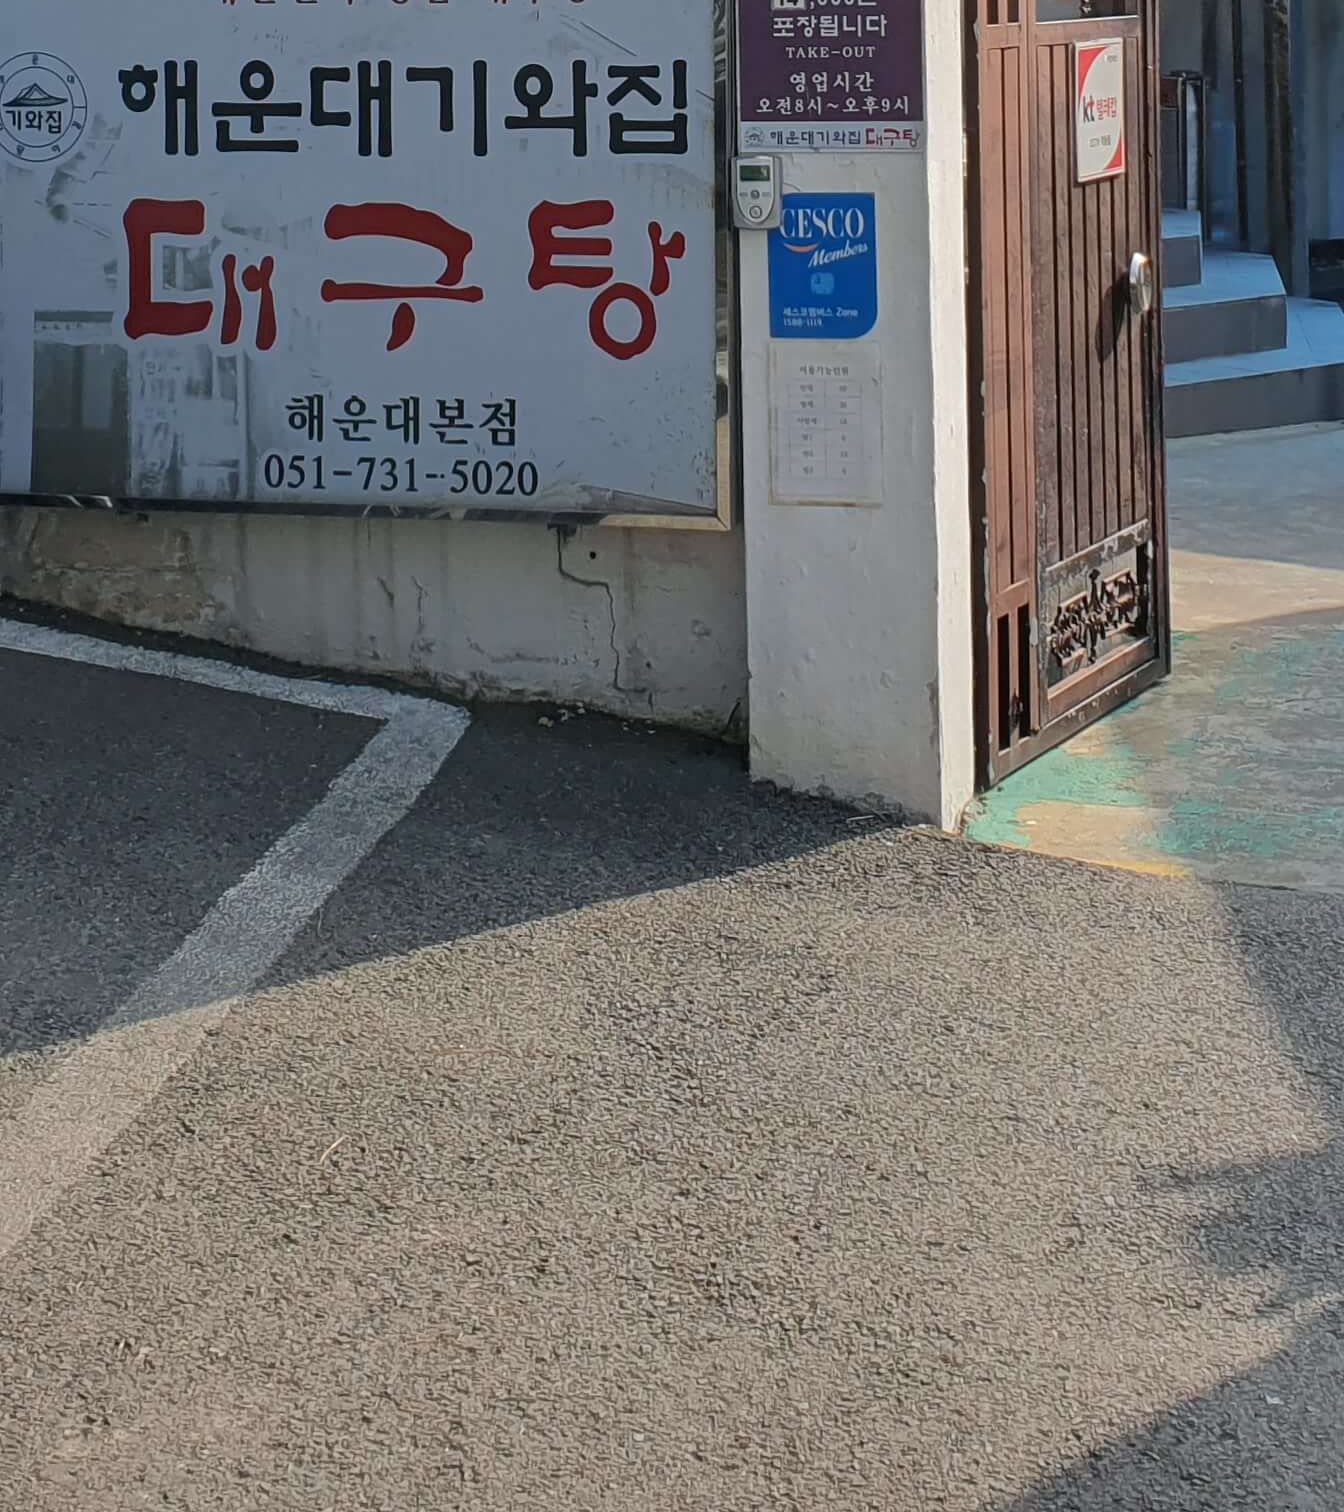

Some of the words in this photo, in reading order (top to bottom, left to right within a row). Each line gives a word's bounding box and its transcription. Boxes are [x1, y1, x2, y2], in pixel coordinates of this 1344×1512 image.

[773, 14, 888, 37] 포장됩니다
[786, 46, 876, 59] TAKE-OUT
[789, 71, 875, 93] 영업시간
[4, 109, 62, 135] 기와집
[117, 59, 689, 158] 해운대기와집
[770, 130, 862, 146] 해운대기와집
[865, 128, 920, 148] 대구탕
[779, 207, 865, 239] CESCO
[808, 240, 869, 268] Members
[122, 199, 686, 360] 대구탕
[284, 394, 519, 446] 해운대본점
[263, 454, 539, 497] 051-731-5020
